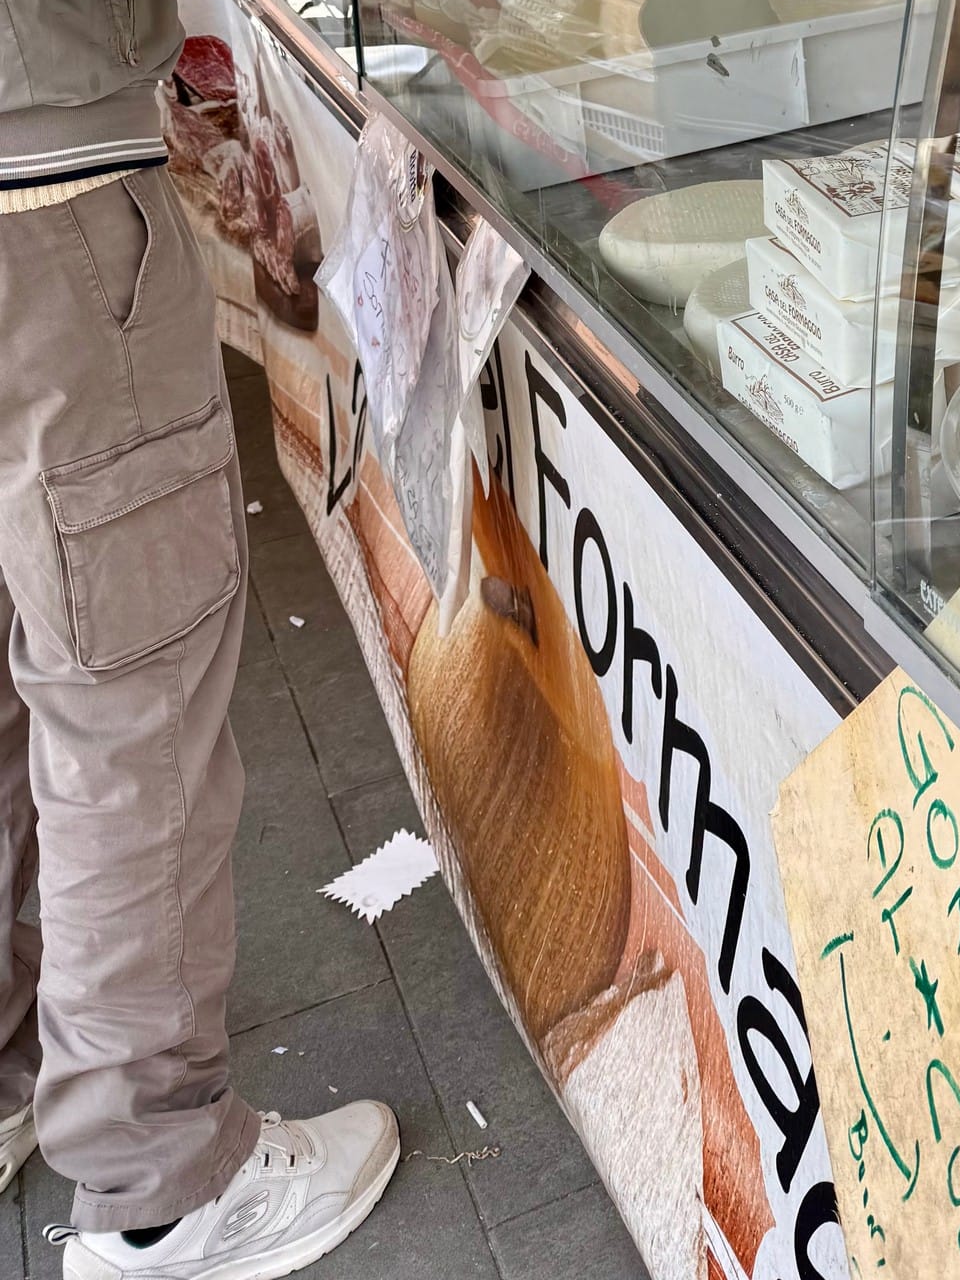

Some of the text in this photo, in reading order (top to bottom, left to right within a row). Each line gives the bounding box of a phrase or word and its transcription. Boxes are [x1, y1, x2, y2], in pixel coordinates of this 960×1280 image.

[793, 219, 822, 255] FORMAGGIO
[787, 302, 823, 340] FORMAGGIO
[728, 346, 745, 371] Burro
[764, 333, 800, 363] CASA DEL
[808, 370, 840, 396] Burro
[920, 579, 945, 613] EXTR
